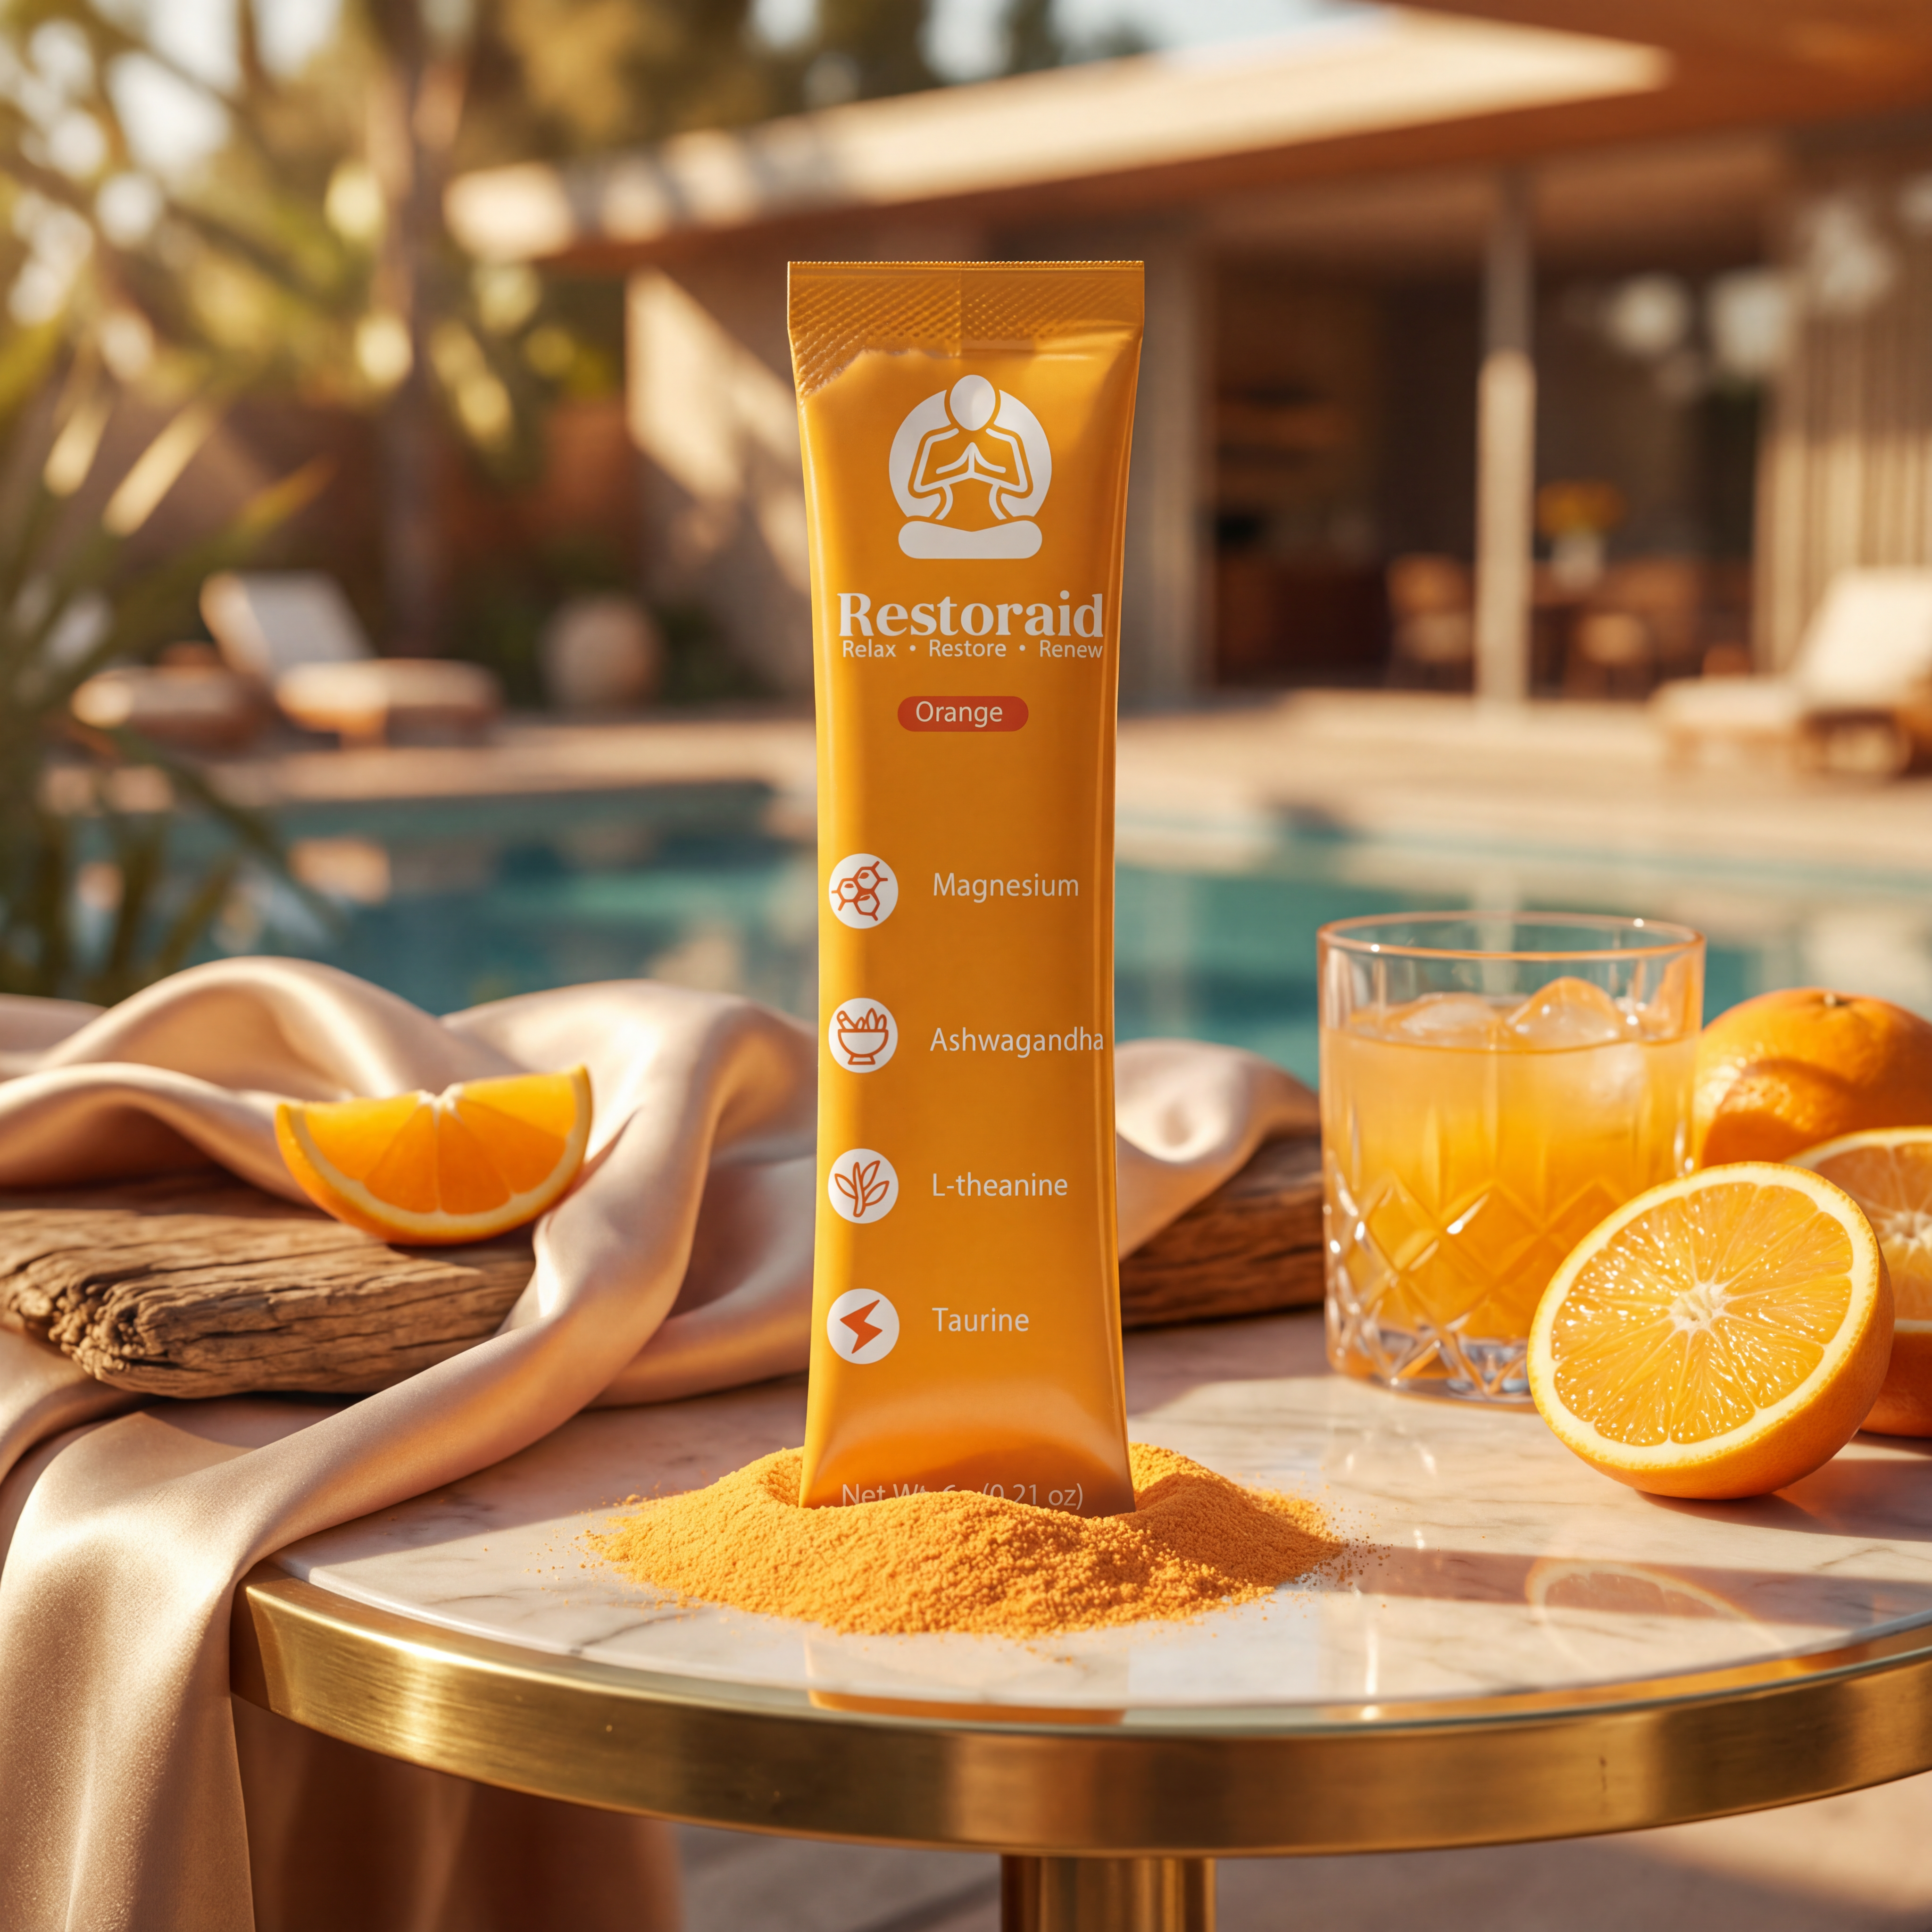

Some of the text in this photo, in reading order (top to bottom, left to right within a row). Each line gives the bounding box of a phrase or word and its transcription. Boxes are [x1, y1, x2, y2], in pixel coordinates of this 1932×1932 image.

[837, 590, 1103, 637] Restoraid
[842, 639, 1103, 658] Relax Restore Renew
[916, 700, 1003, 728] Orange
[933, 873, 1079, 903] Magnesium
[929, 1026, 1104, 1058] Ashwagandha
[933, 1172, 1068, 1197] L-theanine
[932, 1307, 1029, 1332] Taurine
[842, 1483, 886, 1507] Net
[1048, 1482, 1083, 1510] oz)
